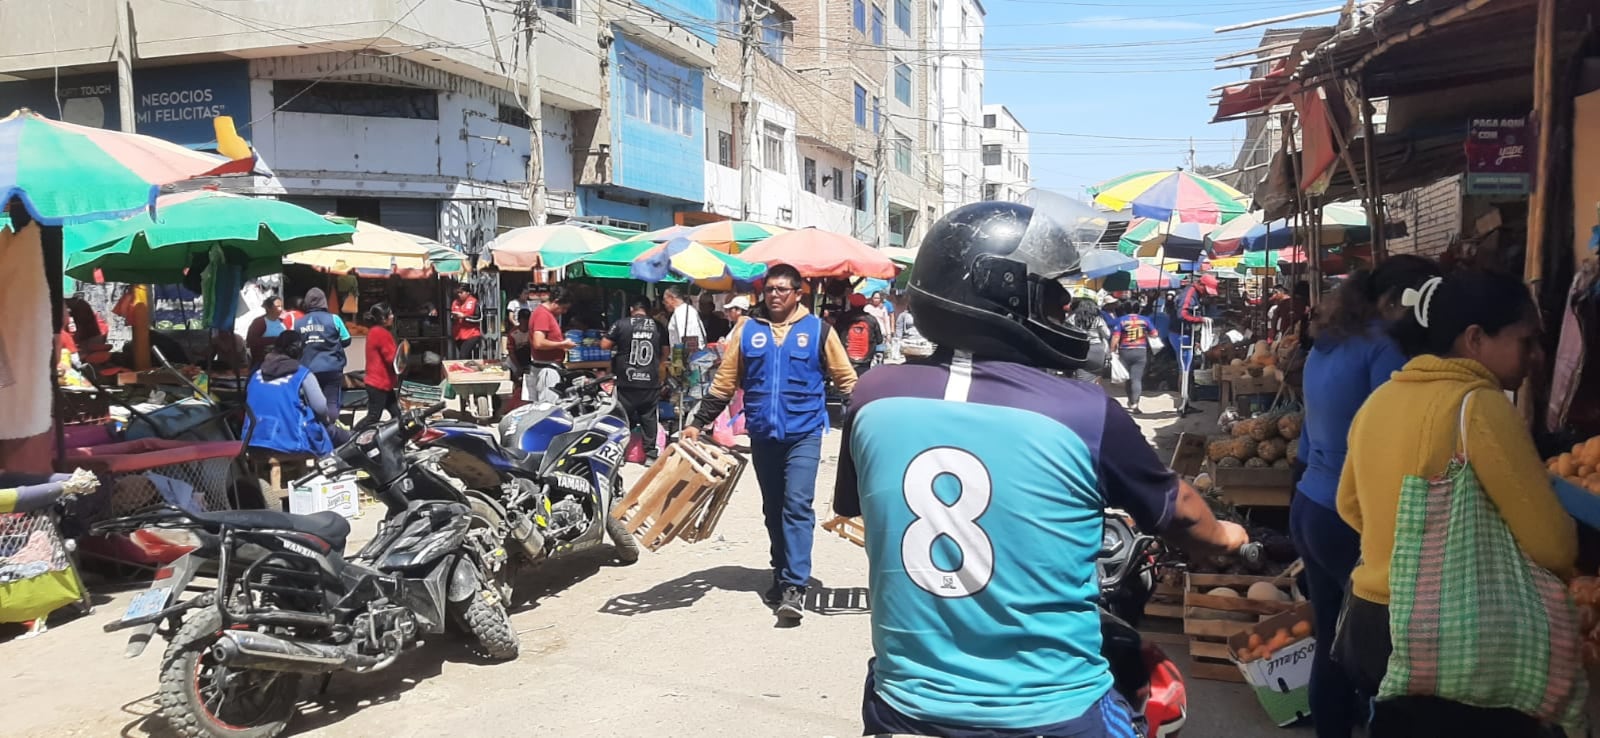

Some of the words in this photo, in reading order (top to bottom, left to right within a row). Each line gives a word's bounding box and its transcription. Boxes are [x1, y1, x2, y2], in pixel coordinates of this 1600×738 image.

[80, 84, 112, 96] TOUCH
[142, 88, 213, 107] NEGOCIOS
[1473, 119, 1498, 127] PAGA
[1495, 145, 1524, 166] yape
[629, 340, 653, 366] 10
[557, 475, 590, 494] YAMAHA
[901, 445, 995, 598] 8
